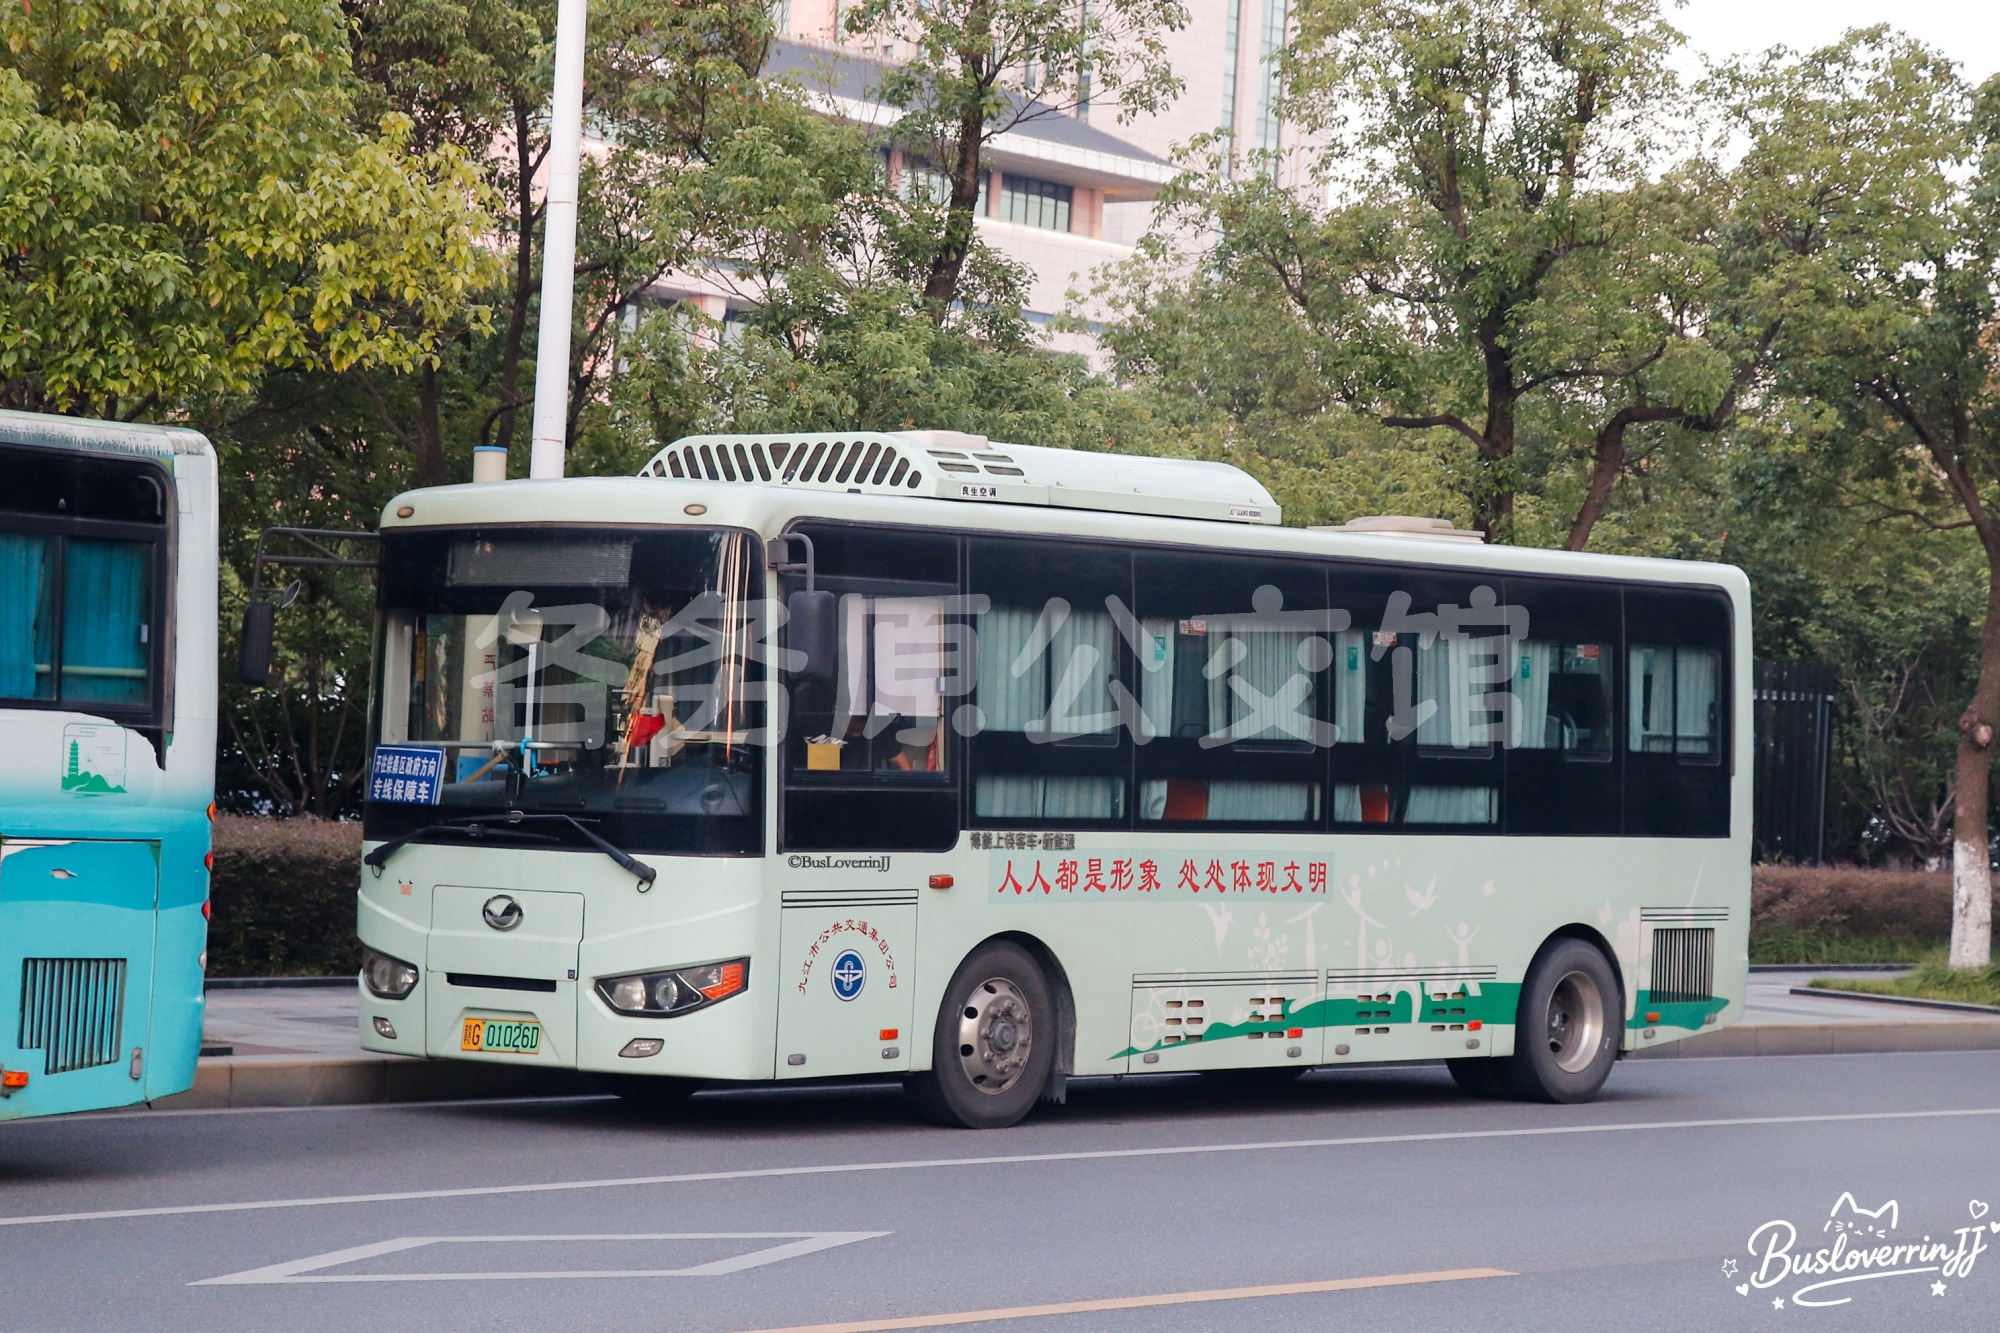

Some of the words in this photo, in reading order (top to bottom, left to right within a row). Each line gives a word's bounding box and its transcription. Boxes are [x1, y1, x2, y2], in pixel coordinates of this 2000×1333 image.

[962, 485, 997, 498] 良生空调
[375, 754, 437, 778] 开往柴桑区政府方向
[373, 777, 431, 803] 专线保障车
[998, 857, 1162, 895] 人人都是形象
[1177, 858, 1328, 895] 处处体现文明
[798, 918, 898, 995] 九江市公共交通集团公司
